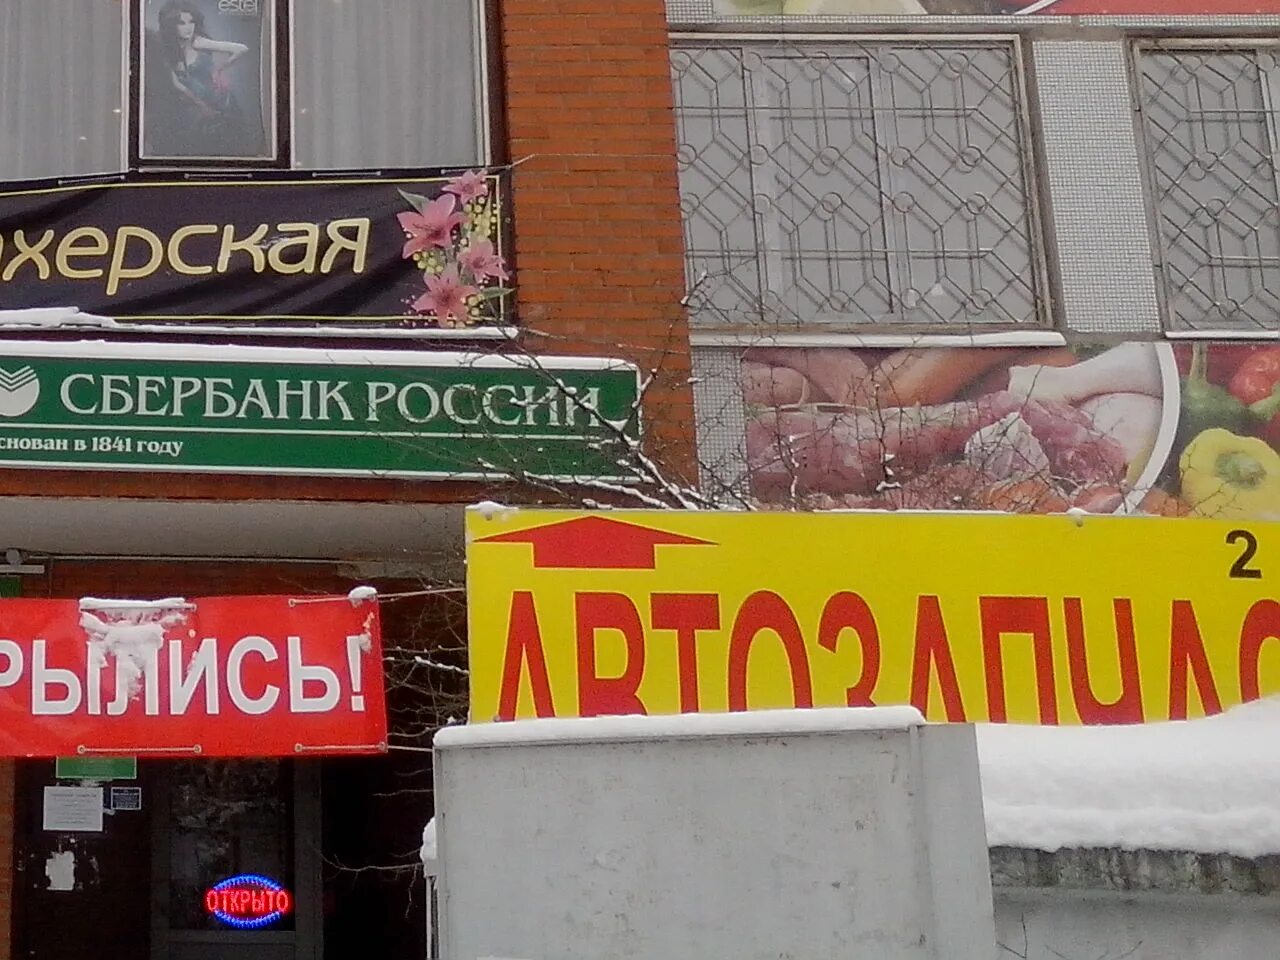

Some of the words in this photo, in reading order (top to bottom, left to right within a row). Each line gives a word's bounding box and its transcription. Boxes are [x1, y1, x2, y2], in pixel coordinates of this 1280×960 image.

[60, 373, 352, 421] СБЕРБАНК
[365, 380, 601, 427] РОССИИ
[74, 439, 87, 452] в
[92, 437, 132, 452] 1841
[136, 441, 184, 457] году
[1225, 529, 1263, 579] 2
[206, 889, 289, 913] ОТКРЫТО
